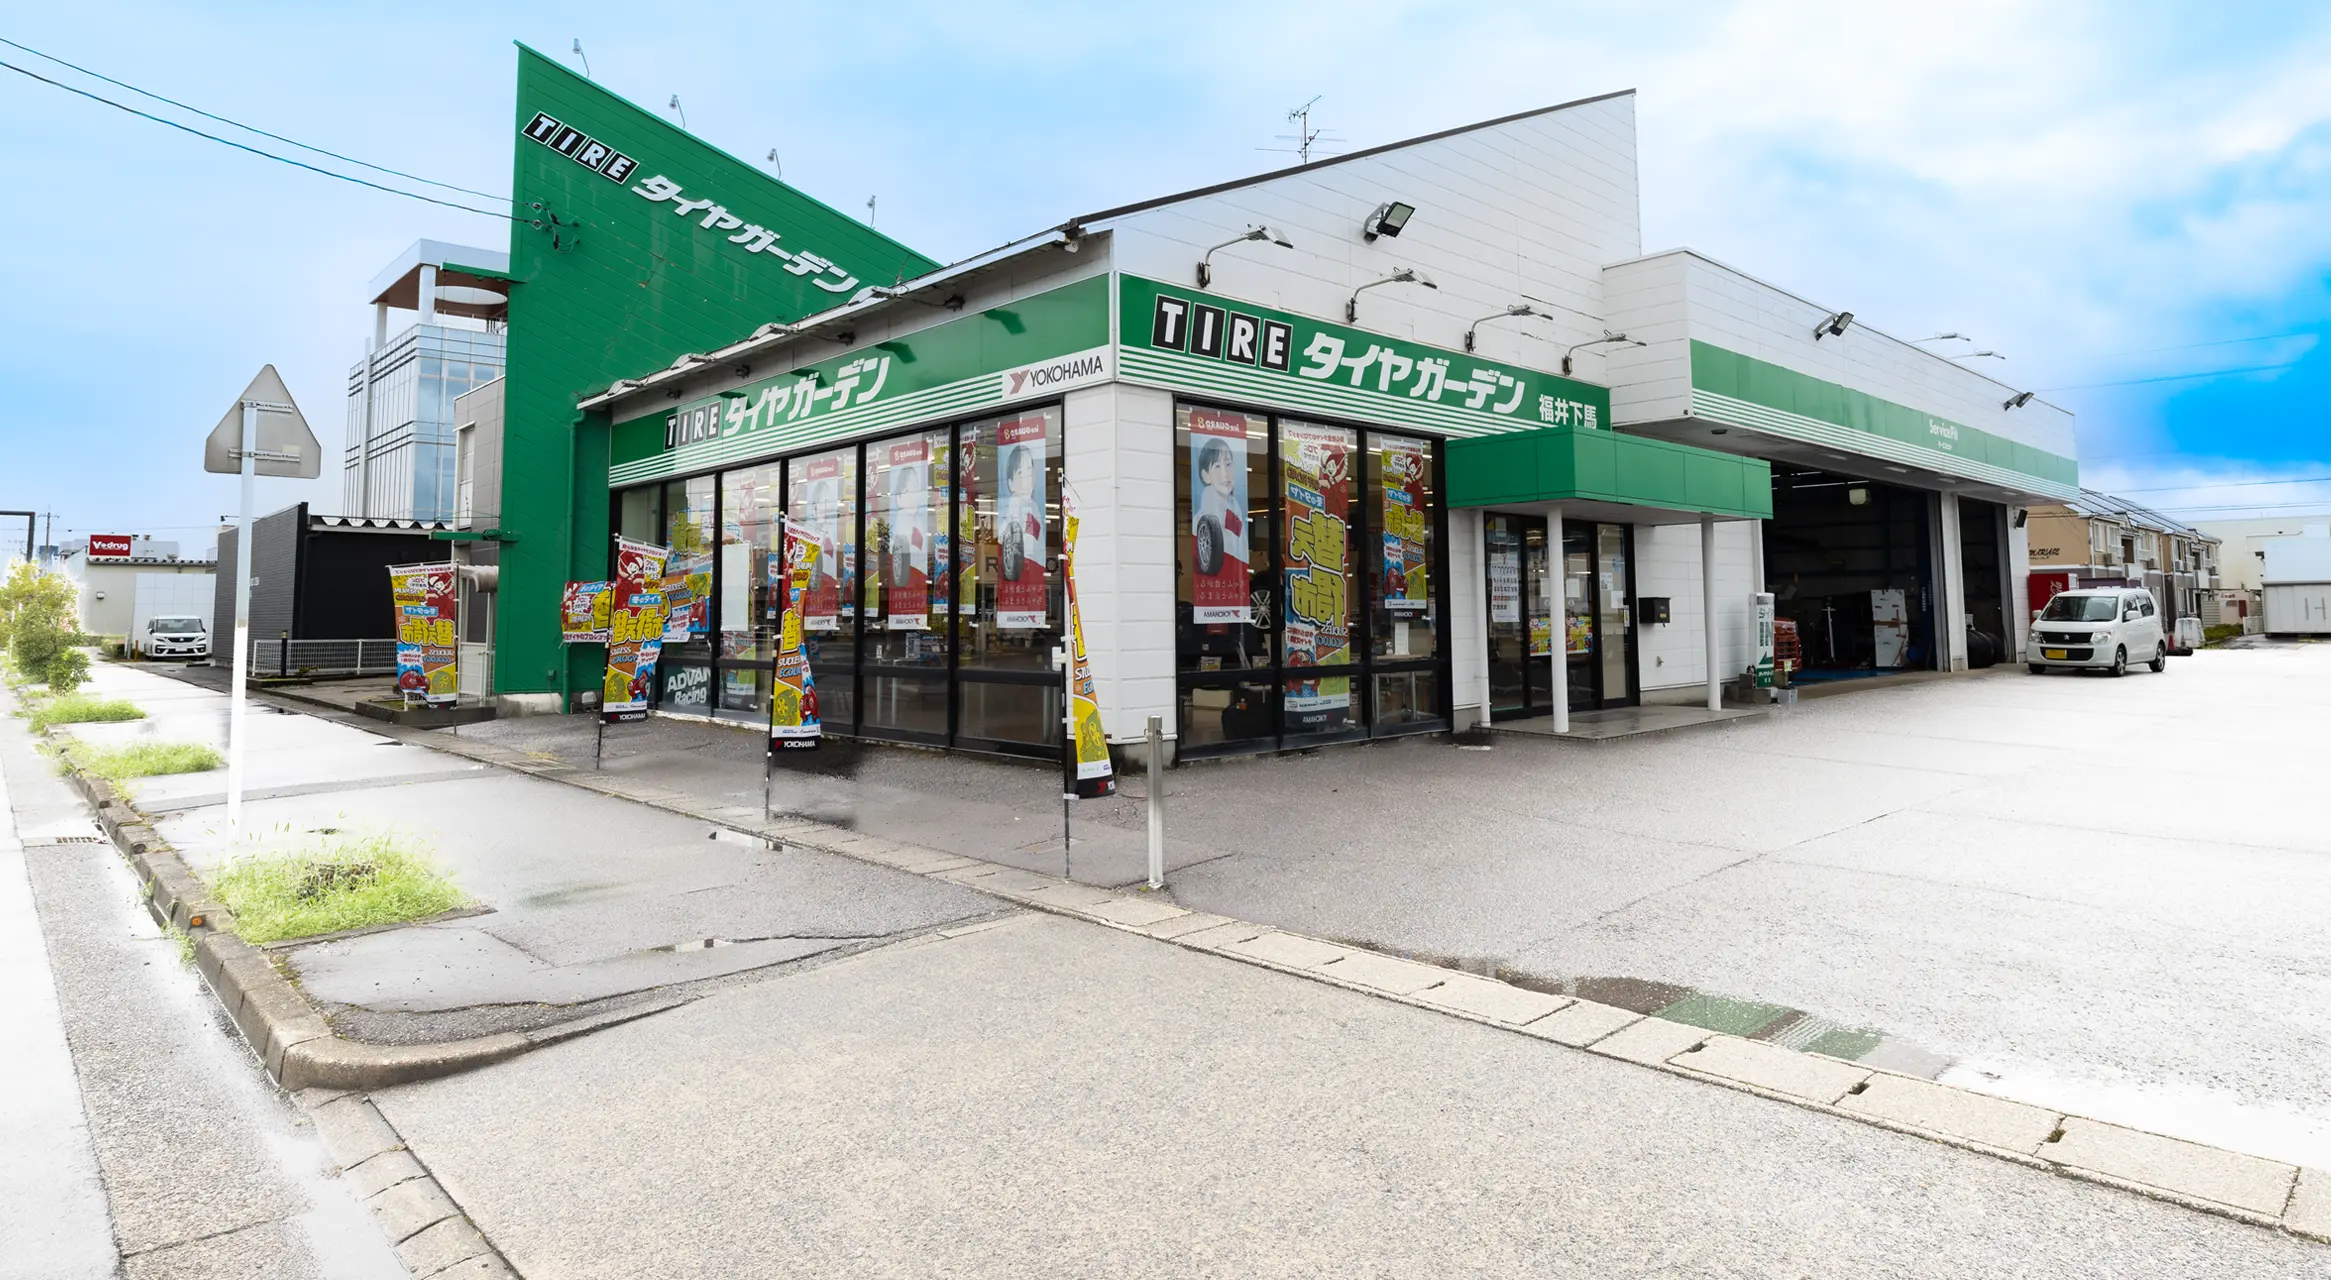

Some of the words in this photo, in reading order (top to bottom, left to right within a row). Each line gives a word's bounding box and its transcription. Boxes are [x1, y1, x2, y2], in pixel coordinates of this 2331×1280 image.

[530, 112, 634, 181] TIRE
[631, 174, 859, 293] タイヤガーデン
[1029, 354, 1104, 387] YOKOHAMA
[1157, 299, 1288, 369] TIRE
[1299, 331, 1525, 413] タイヤガーデン
[1538, 393, 1597, 430] 福井下馬
[666, 403, 721, 450] TIRE
[722, 356, 890, 438] タイヤガーデン
[667, 667, 711, 693] ADVAN
[674, 681, 707, 706] Racing
[783, 740, 816, 748] YOKOHAMA
